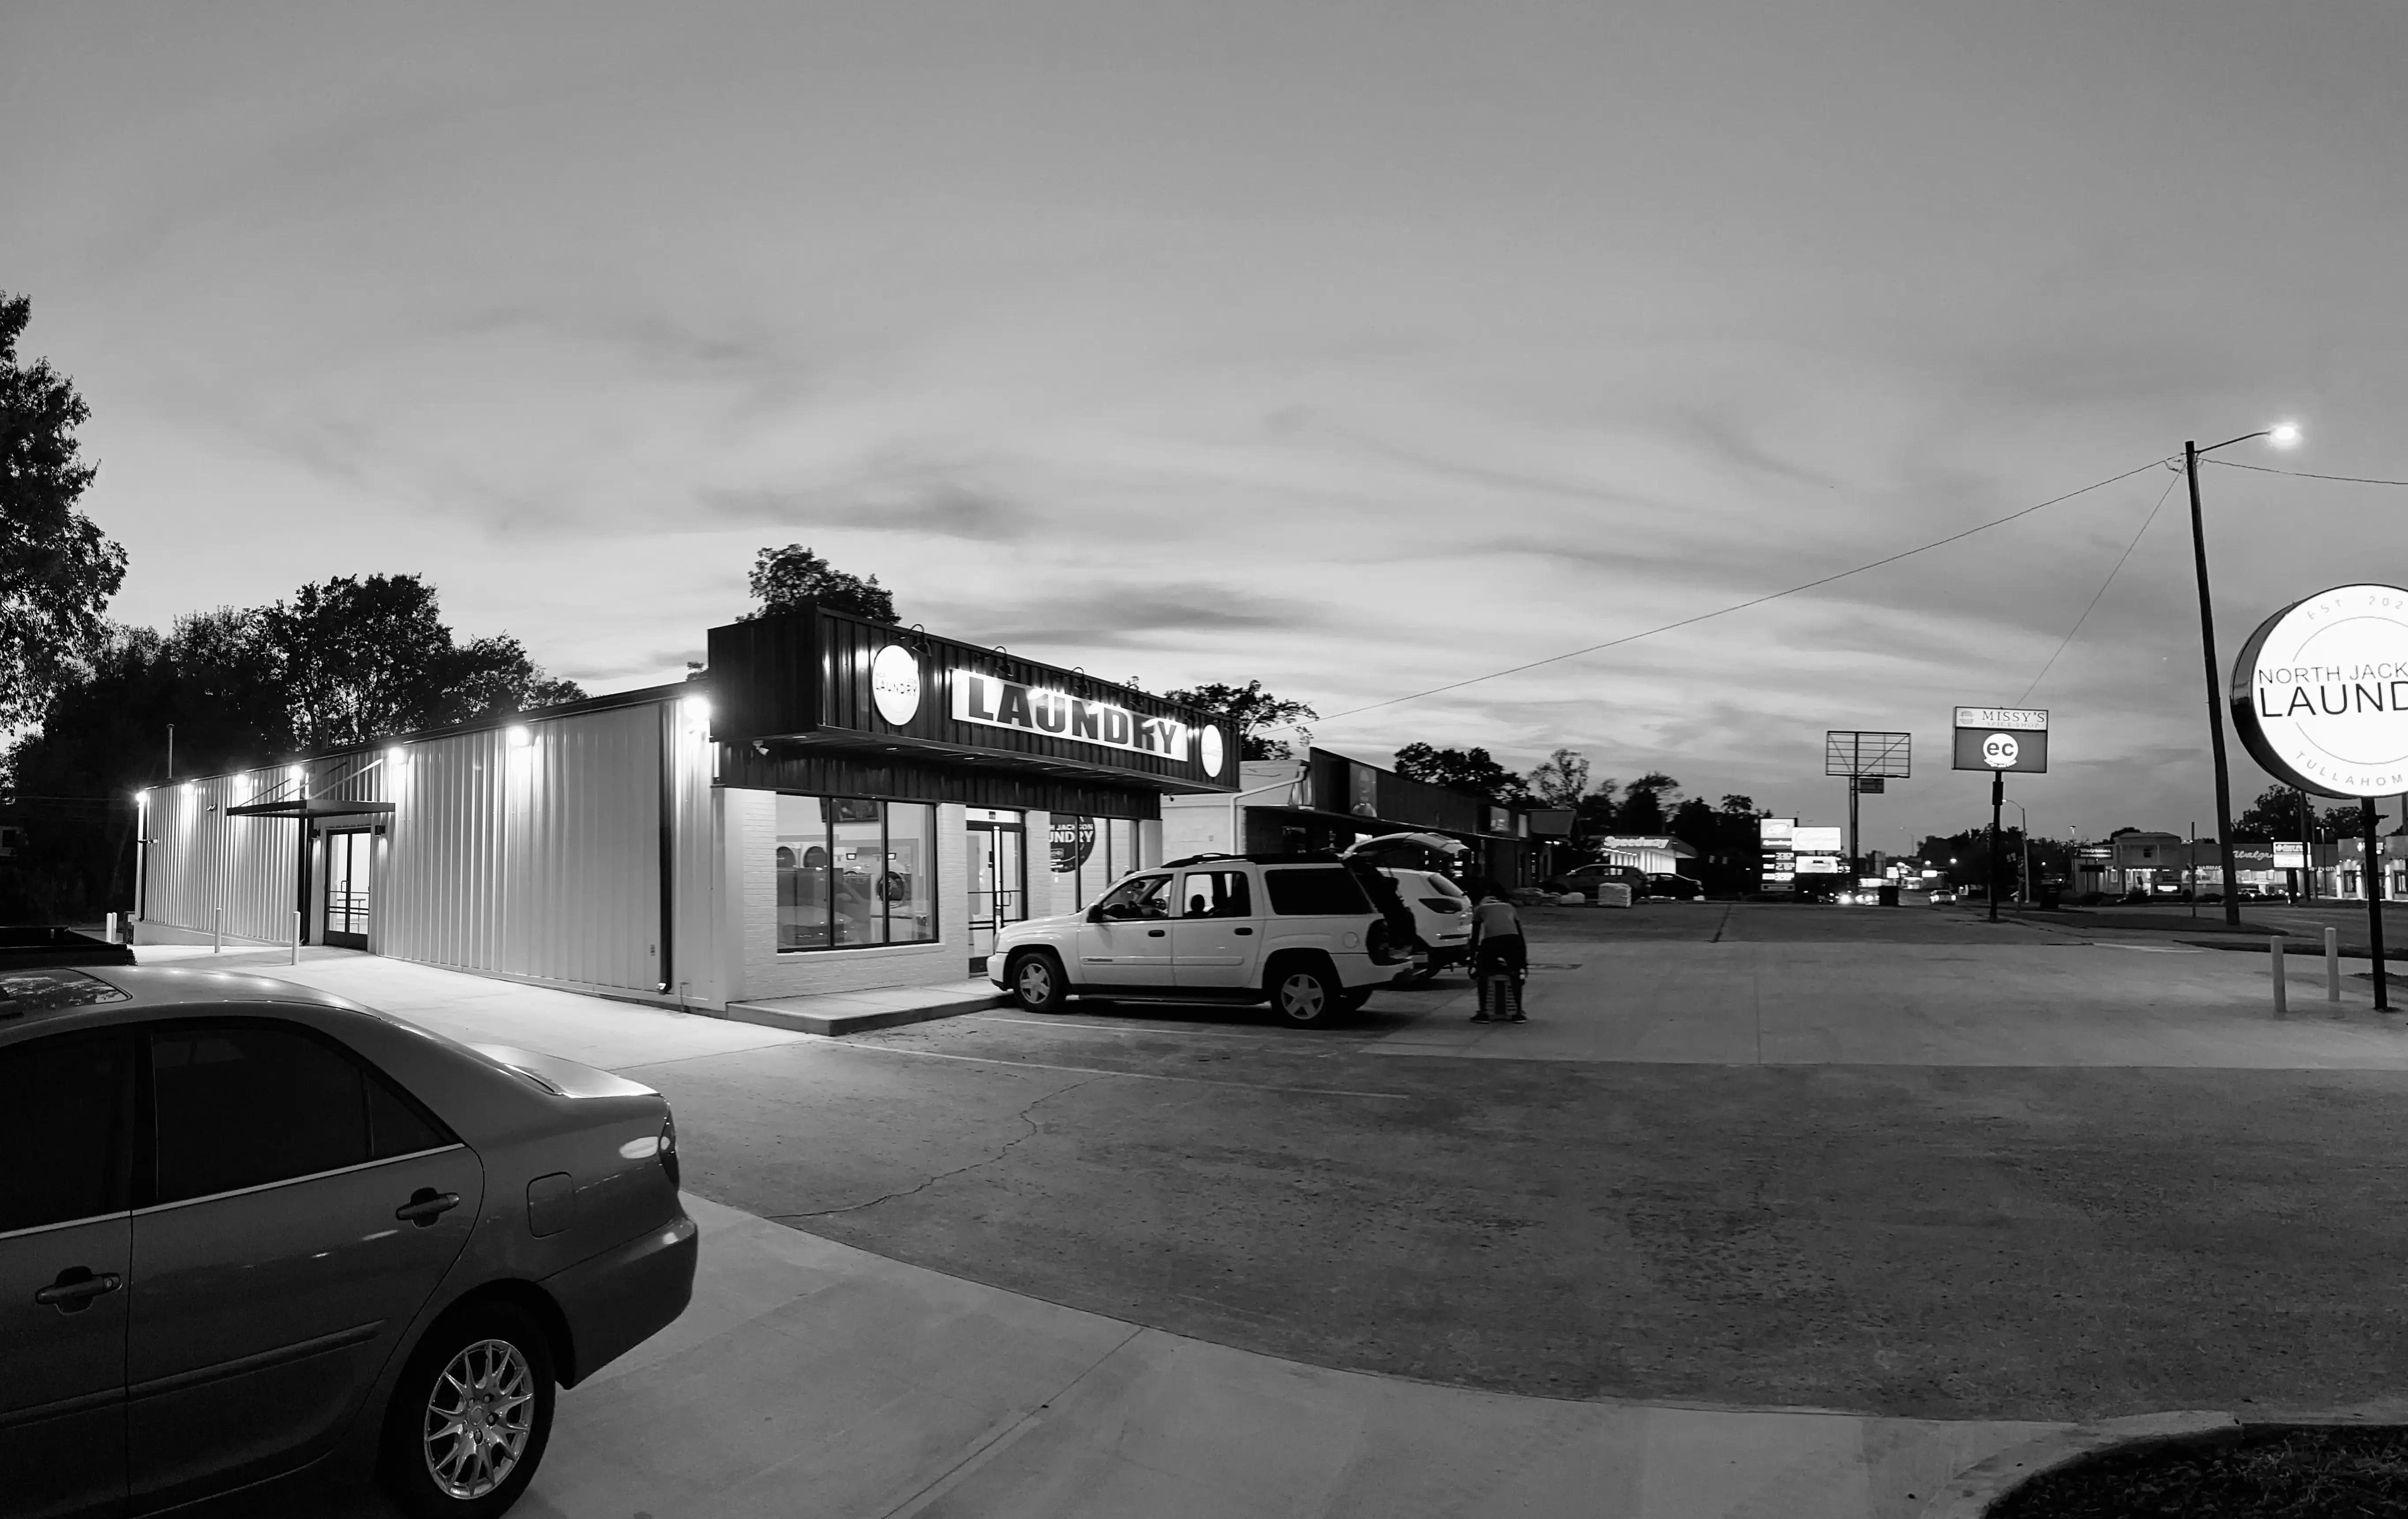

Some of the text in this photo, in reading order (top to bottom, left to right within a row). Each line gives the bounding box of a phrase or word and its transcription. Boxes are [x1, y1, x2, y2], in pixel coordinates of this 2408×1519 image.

[2307, 596, 2404, 619] EST 202
[2259, 662, 2408, 685] NORTH JACK
[2260, 681, 2408, 717] LAUND
[969, 676, 1178, 754] LAUNDRY
[1982, 711, 2045, 723] MISSY'S
[2296, 751, 2403, 786] TULLAHOM
[1049, 831, 1094, 843] UNDRY
[2232, 850, 2273, 861] Walgr
